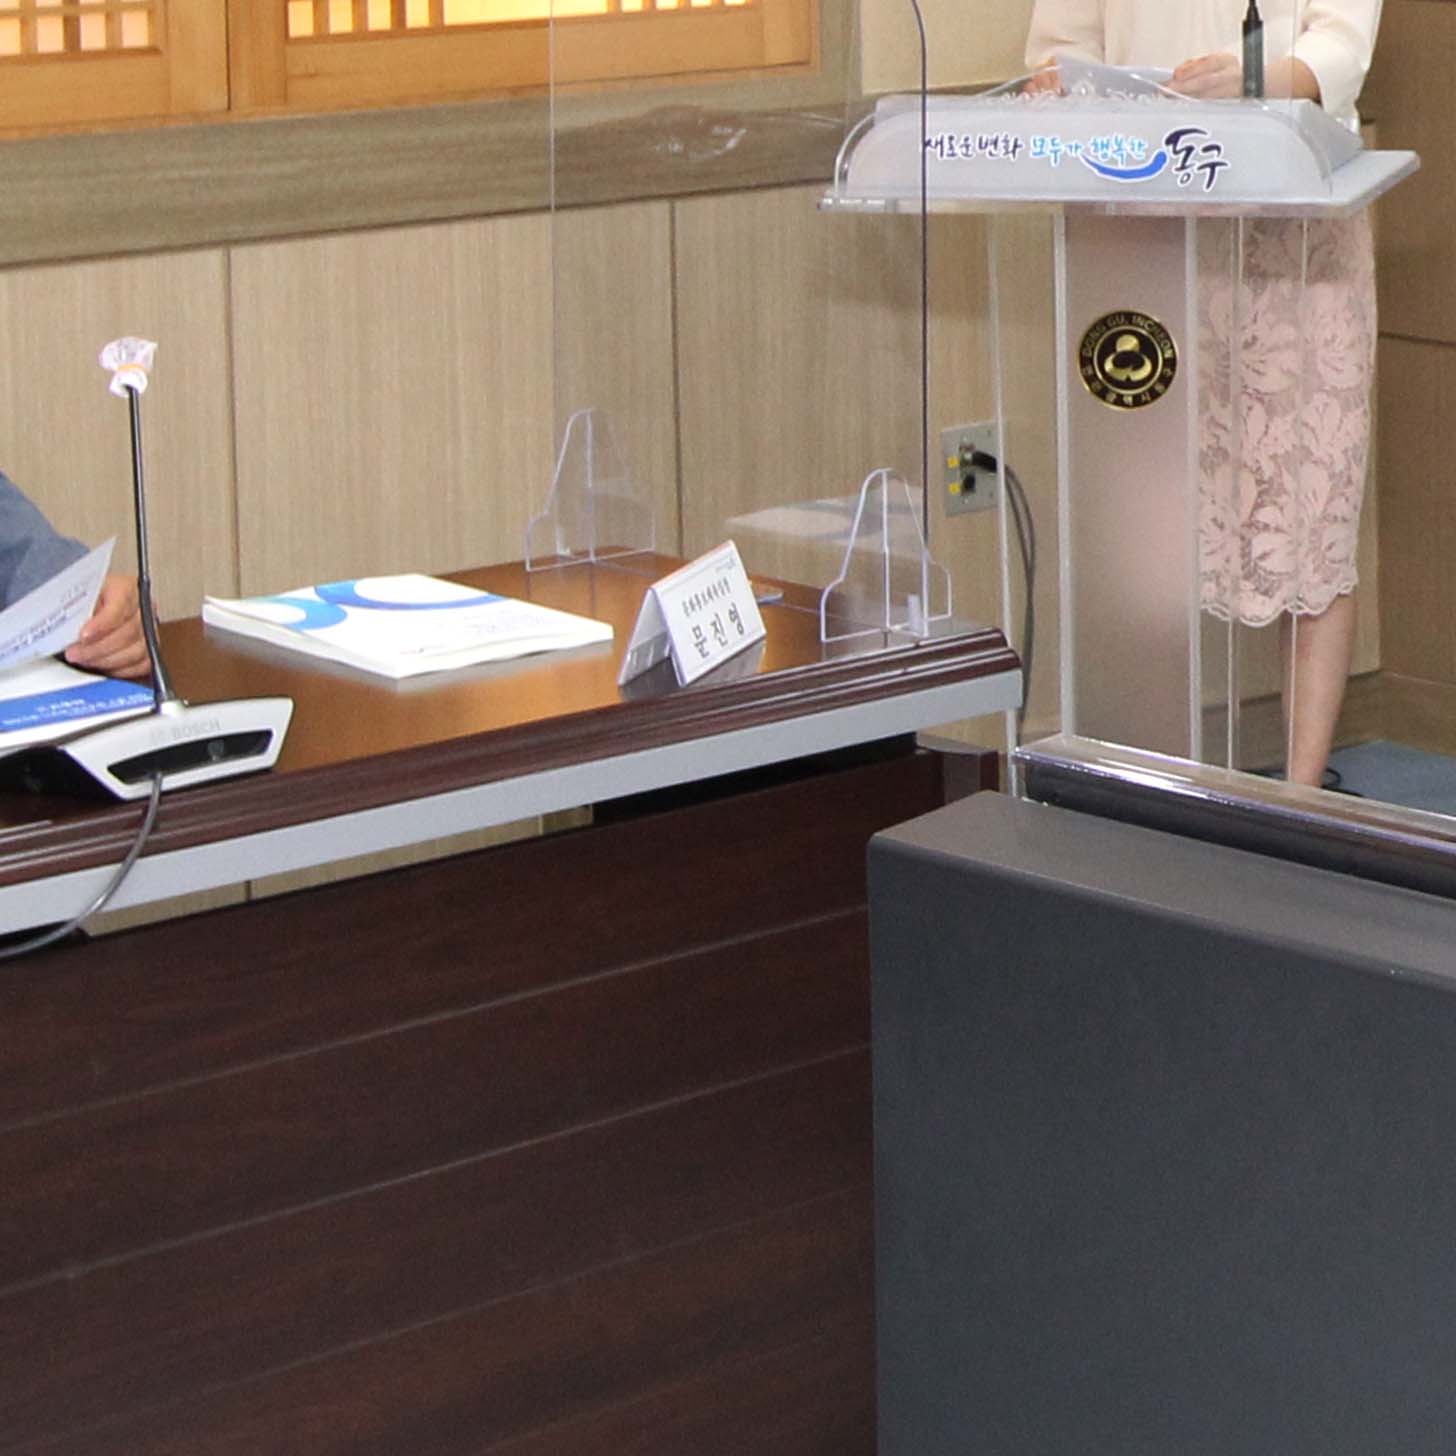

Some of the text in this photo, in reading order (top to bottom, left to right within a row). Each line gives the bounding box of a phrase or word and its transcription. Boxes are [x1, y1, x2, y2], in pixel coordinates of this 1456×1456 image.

[1030, 135, 1082, 166] 모두가
[1090, 133, 1147, 165] 행복한
[1164, 128, 1228, 189] 동구
